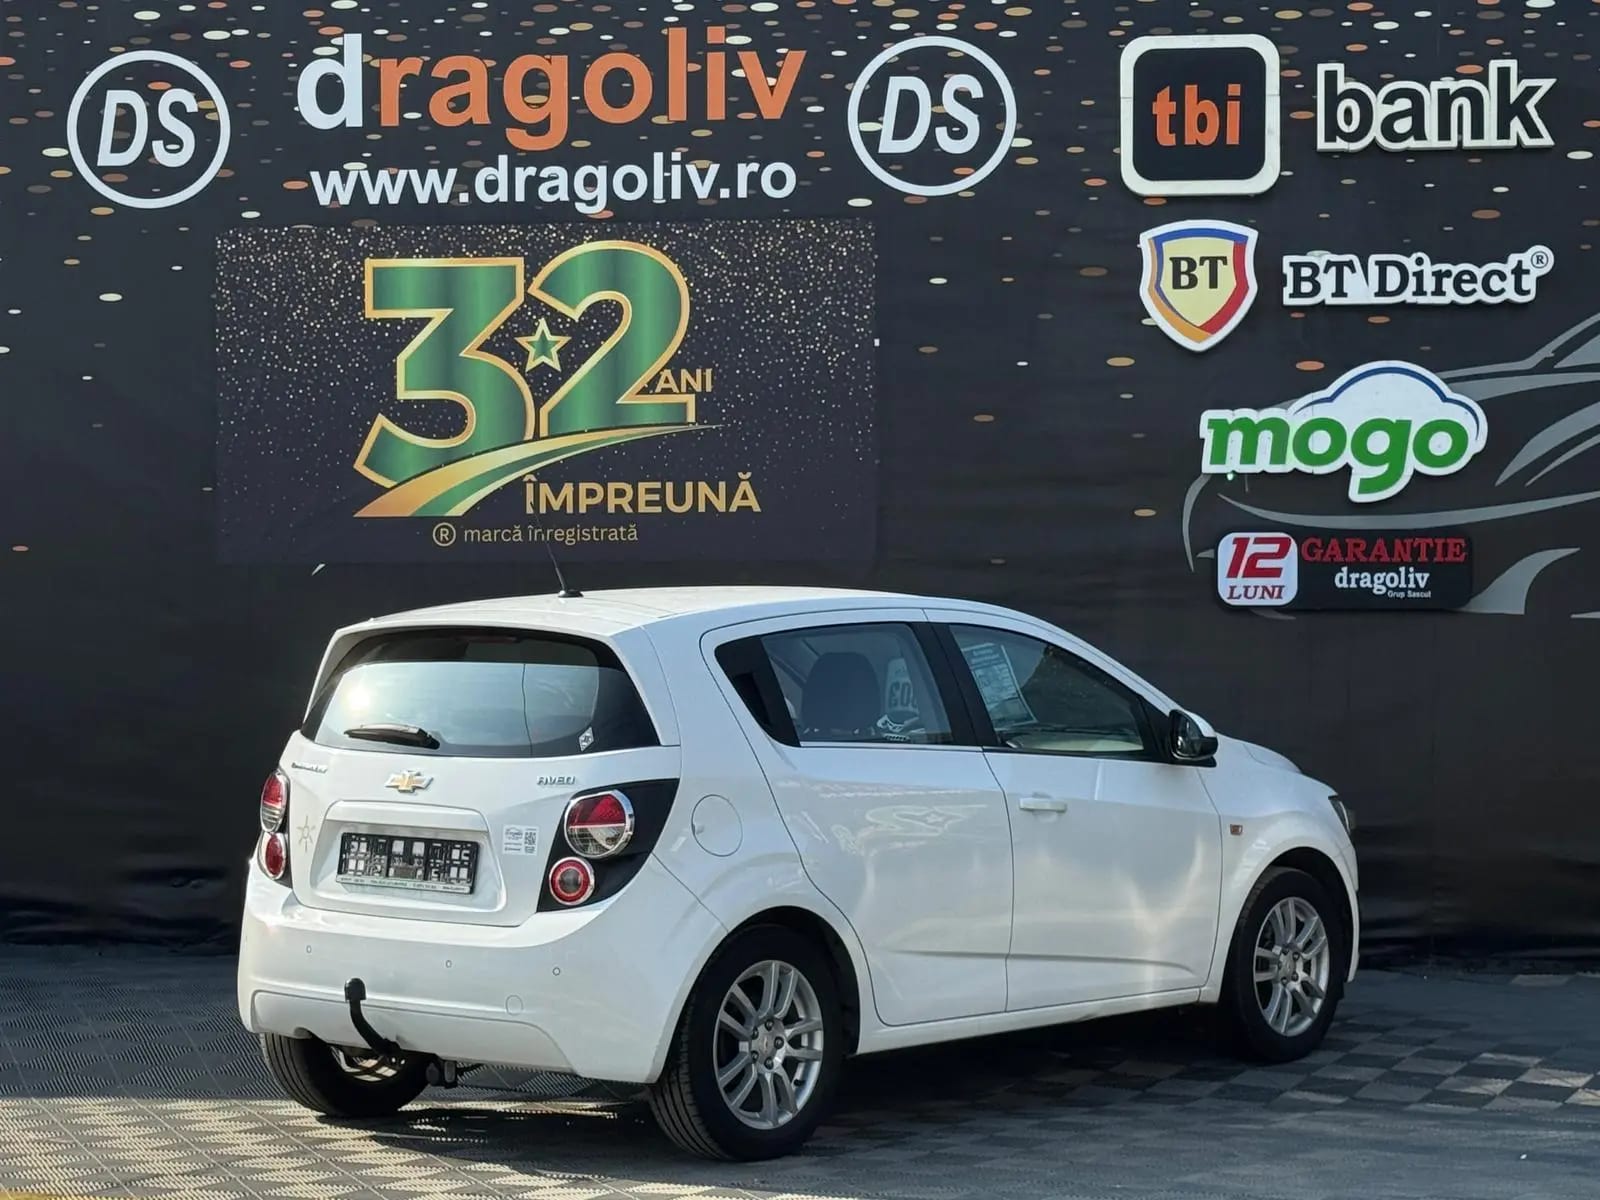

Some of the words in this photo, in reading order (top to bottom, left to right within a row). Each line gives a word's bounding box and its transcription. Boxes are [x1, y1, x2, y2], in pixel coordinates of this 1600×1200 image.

[297, 27, 806, 152] dragoliv
[1152, 84, 1241, 147] tbi
[1319, 60, 1555, 151] bank
[97, 89, 199, 168] DS
[878, 73, 984, 155] DS
[310, 152, 797, 215] www.dragoliv.ro
[1170, 256, 1228, 291] BT
[1288, 259, 1357, 299] BT
[655, 368, 713, 393] ANI
[1206, 416, 1469, 495] mogo
[523, 471, 762, 514] ÎMPREUNĂ
[463, 524, 523, 543] marcă
[527, 524, 639, 546] înregistrată
[1300, 535, 1468, 563] GARANTIE
[1225, 536, 1292, 579] 12
[1226, 584, 1285, 600] LUNI
[1334, 566, 1430, 595] dragoliv
[1387, 590, 1405, 599] Grup
